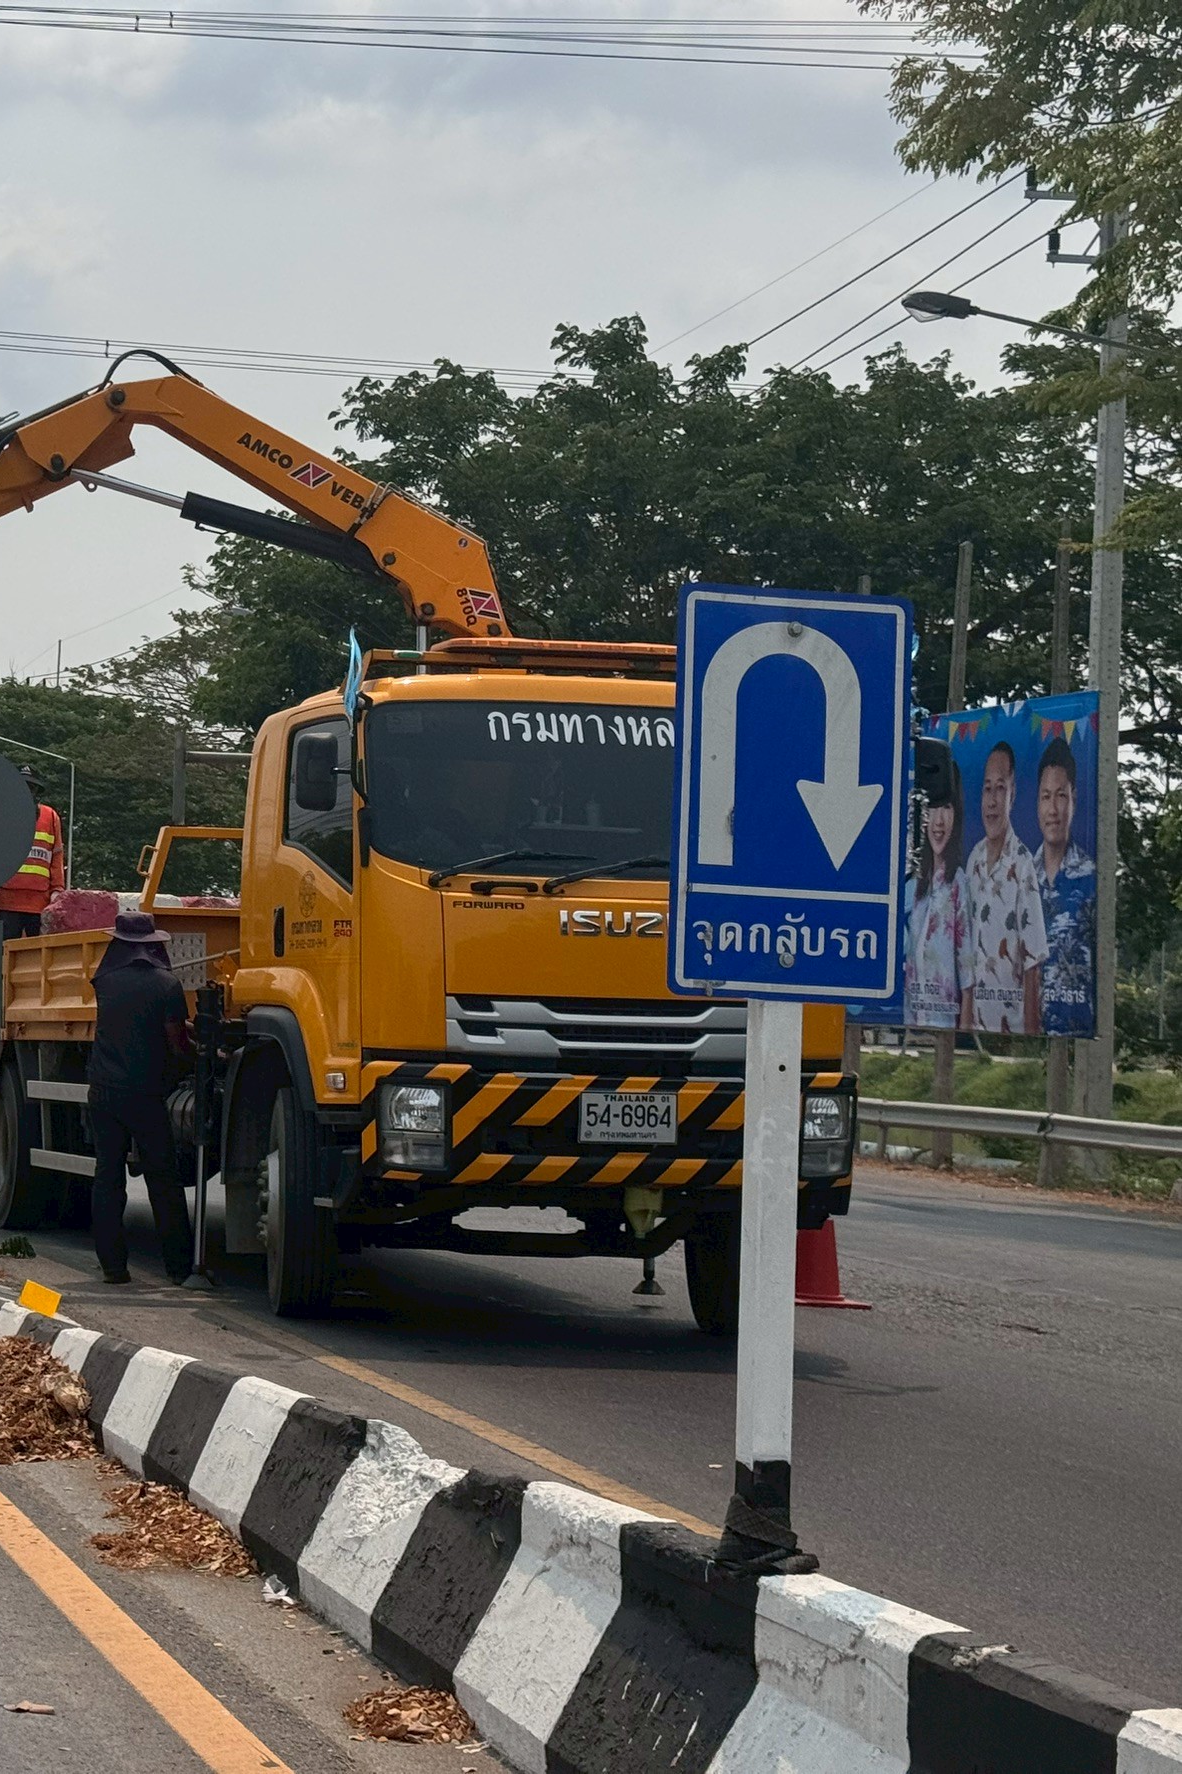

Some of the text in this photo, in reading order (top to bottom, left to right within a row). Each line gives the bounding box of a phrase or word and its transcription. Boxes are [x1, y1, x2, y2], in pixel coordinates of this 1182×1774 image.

[237, 432, 369, 511] AMCO VEB
[457, 588, 477, 627] 810Q
[452, 901, 525, 910] FORWARD
[333, 919, 352, 928] FTR
[559, 910, 669, 937] ISUZ
[692, 912, 878, 966] จุดกลับรถ
[604, 1094, 655, 1103] THAILAND
[586, 1103, 671, 1128] 54-6964
